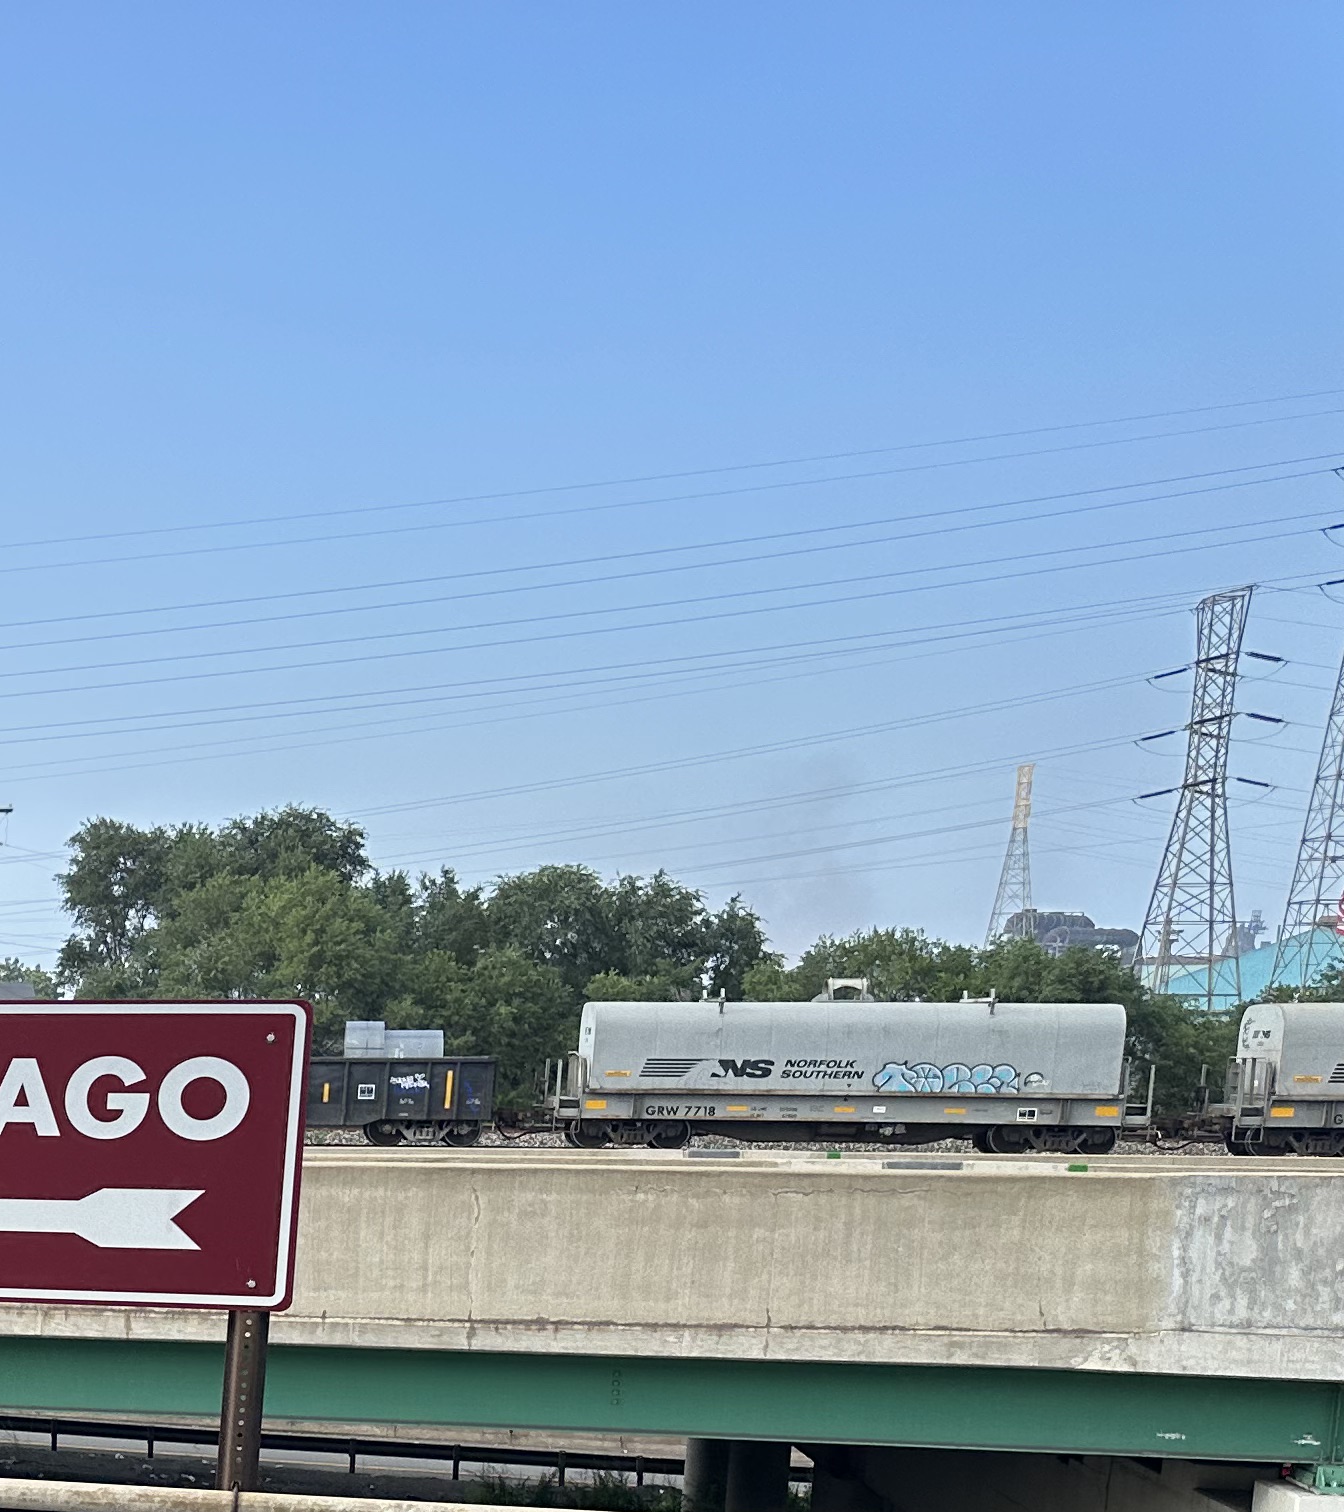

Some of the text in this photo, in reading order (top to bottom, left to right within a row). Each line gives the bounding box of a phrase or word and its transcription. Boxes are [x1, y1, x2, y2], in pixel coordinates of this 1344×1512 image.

[784, 1059, 857, 1069] NORFOLK
[780, 1070, 865, 1079] SOUTHERN
[645, 1105, 716, 1116] GRW 7718
